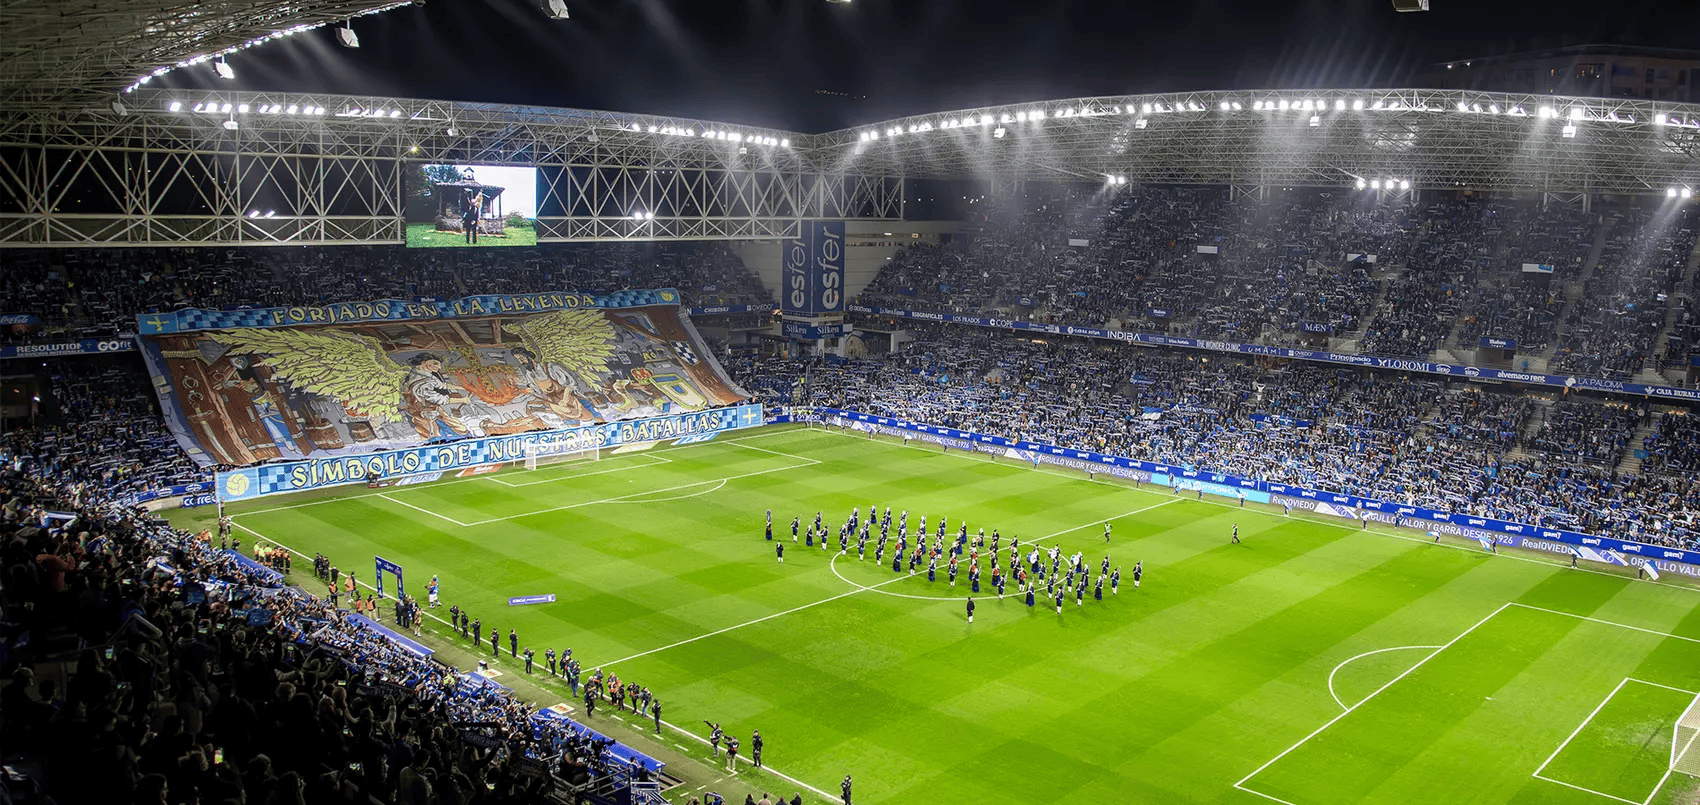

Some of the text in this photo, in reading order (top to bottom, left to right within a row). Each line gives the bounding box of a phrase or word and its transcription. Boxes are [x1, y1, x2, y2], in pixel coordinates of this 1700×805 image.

[788, 239, 805, 308] esfer
[817, 225, 840, 309] esfer
[272, 295, 596, 324] FORJADO EN LA LEYENDA
[786, 324, 807, 334] Silken
[816, 325, 840, 335] Silken
[995, 319, 1014, 328] COPE
[1330, 353, 1371, 363] Principado
[1388, 359, 1430, 372] LOROMI
[1497, 370, 1546, 382] alvemaco rent
[1590, 379, 1624, 389] PALOMA
[290, 412, 720, 487] SÍMBOLO DE NUESTRAS BATALLAS
[1041, 455, 1064, 466] RGULLO
[1065, 458, 1085, 469] VALOR
[1426, 521, 1432, 530] Y
[1433, 523, 1461, 536] GARRA
[1463, 528, 1492, 541] DESDE
